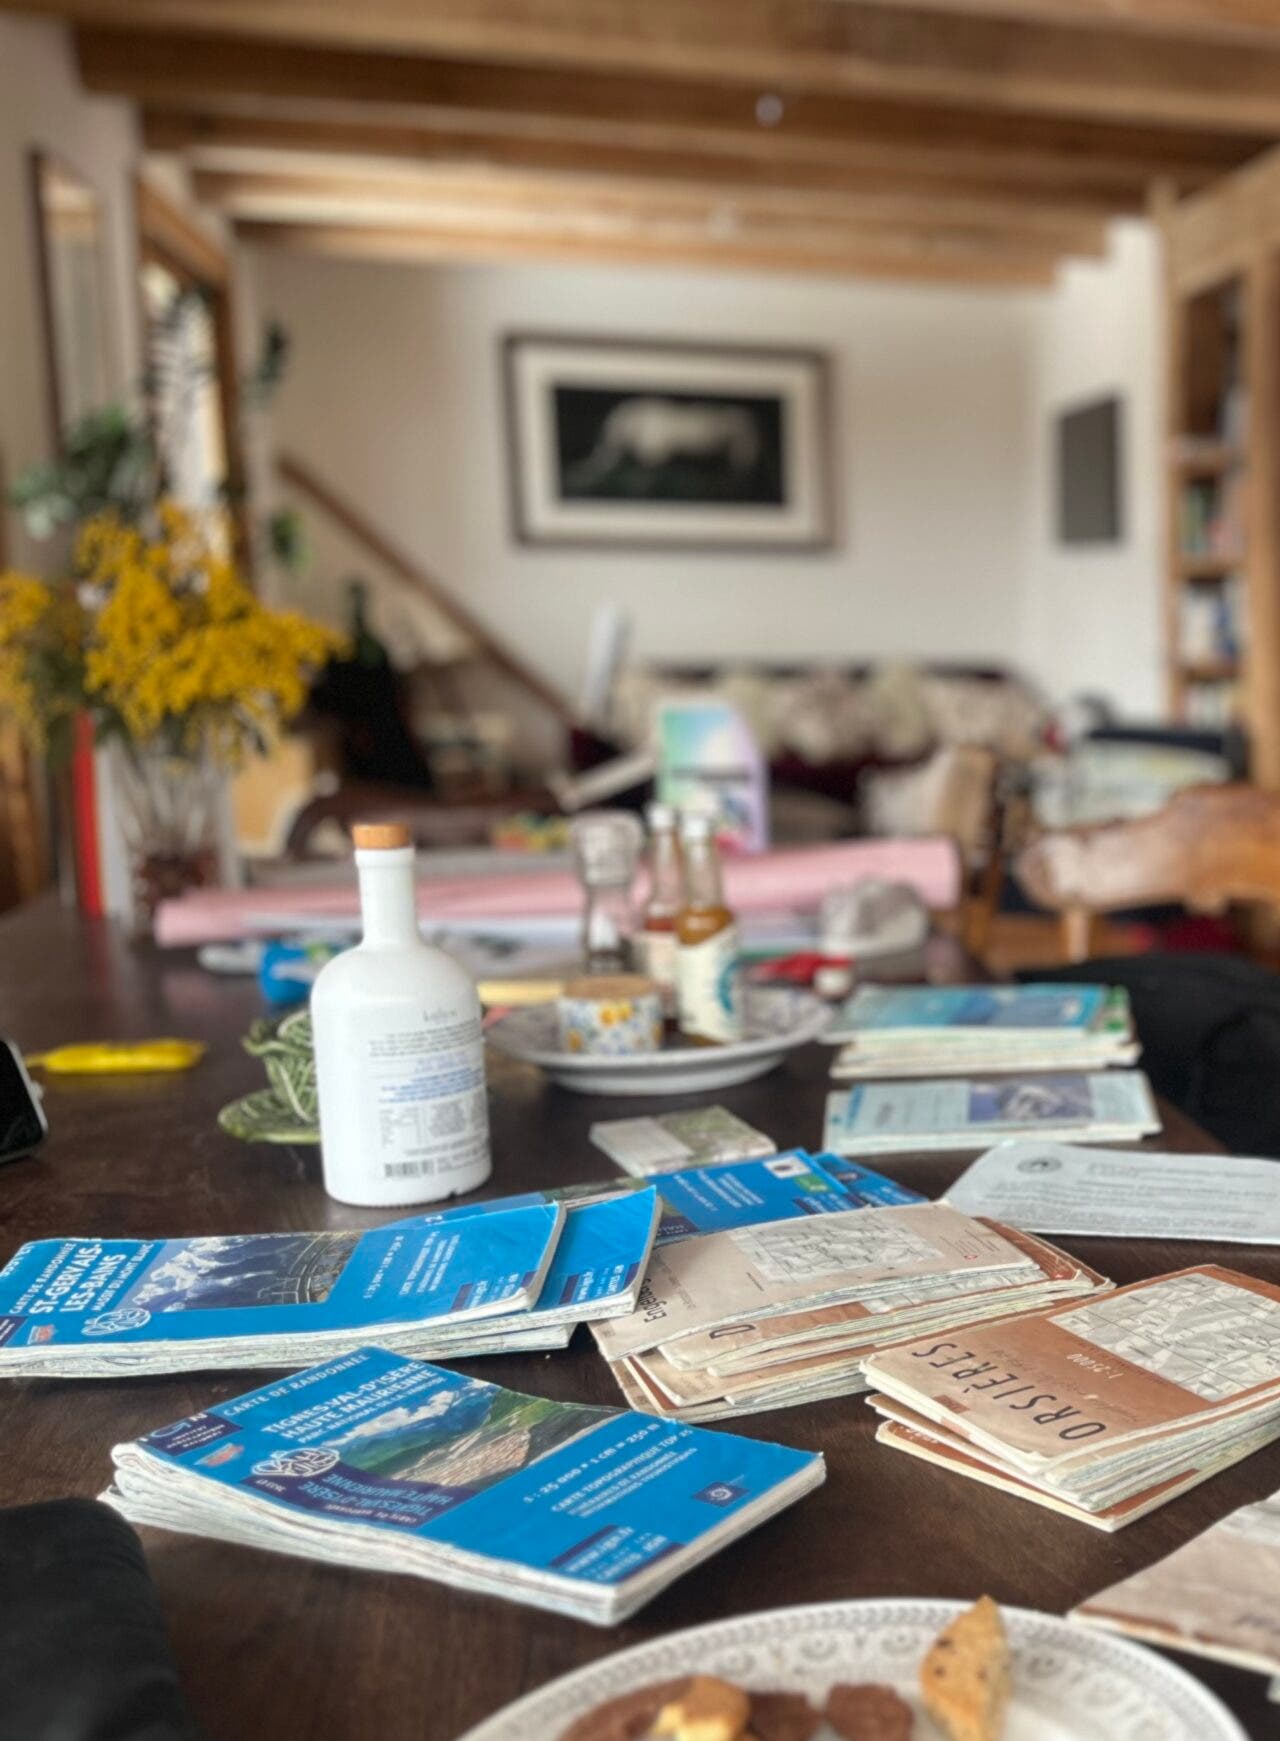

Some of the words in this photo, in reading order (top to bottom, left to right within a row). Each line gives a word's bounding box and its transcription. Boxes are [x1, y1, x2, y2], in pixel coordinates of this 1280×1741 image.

[60, 1254, 127, 1312] LES-BAINS
[224, 1396, 270, 1416] CARTE
[270, 1388, 290, 1397] DE
[281, 1410, 343, 1439] HAUTE
[340, 1369, 438, 1413] MAURIENNE
[912, 1343, 1106, 1441] ORSIÈRES
